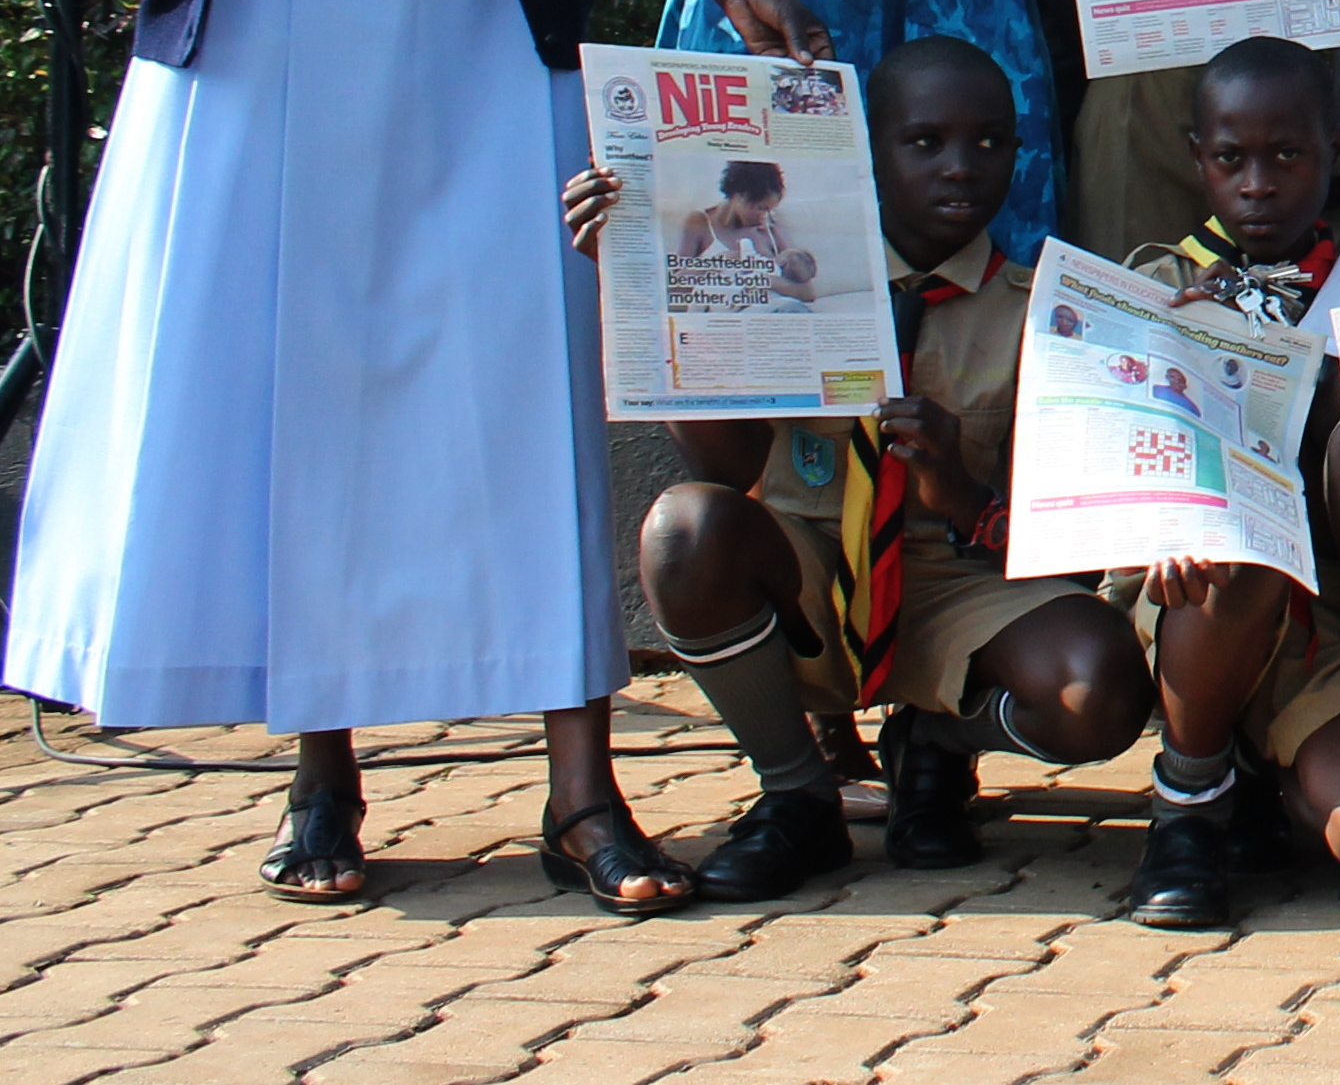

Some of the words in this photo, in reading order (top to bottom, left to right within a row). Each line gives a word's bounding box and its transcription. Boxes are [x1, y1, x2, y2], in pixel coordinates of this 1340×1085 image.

[656, 72, 751, 126] NiE
[667, 254, 775, 273] Breastfeeding
[668, 272, 732, 288] benefits
[734, 272, 770, 287] both
[669, 291, 730, 307] mother,
[732, 290, 769, 305] child
